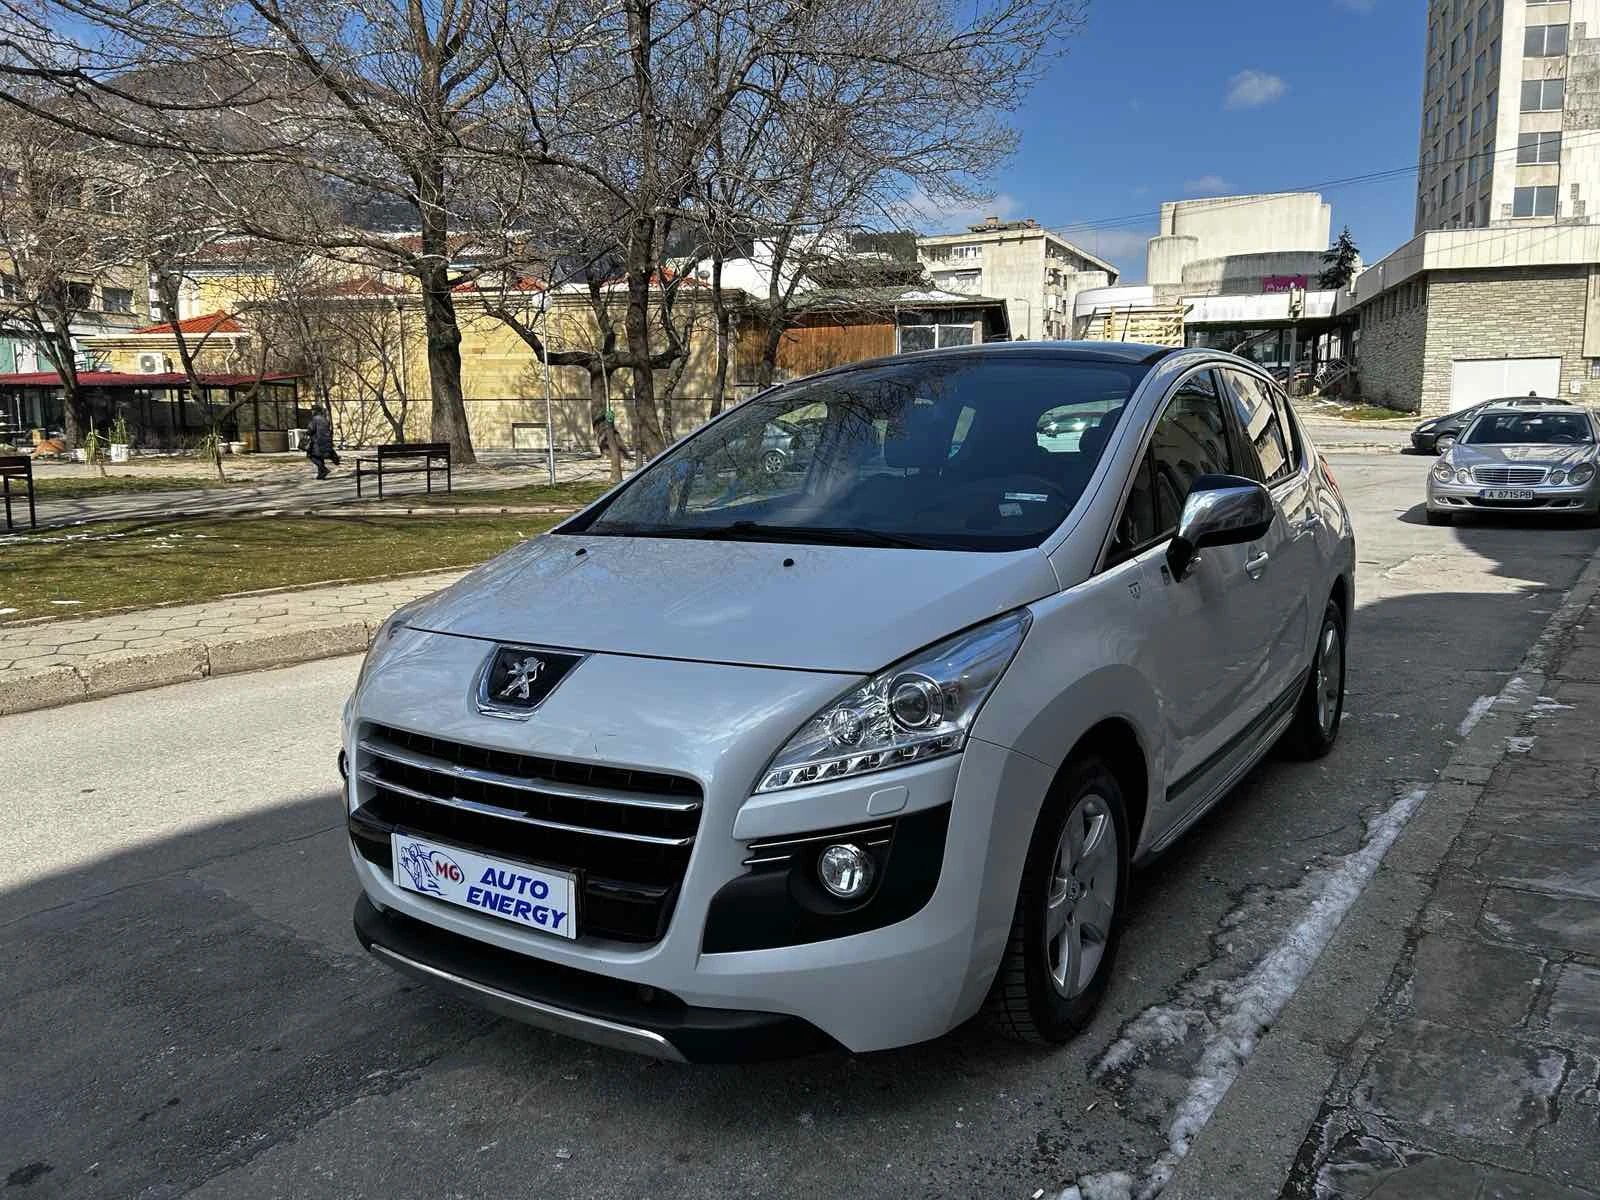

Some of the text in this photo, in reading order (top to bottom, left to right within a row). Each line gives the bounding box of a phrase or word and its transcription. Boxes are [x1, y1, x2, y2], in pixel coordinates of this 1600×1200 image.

[435, 860, 460, 881] MG
[479, 867, 549, 900] AUTO
[466, 886, 567, 929] ENERGY
